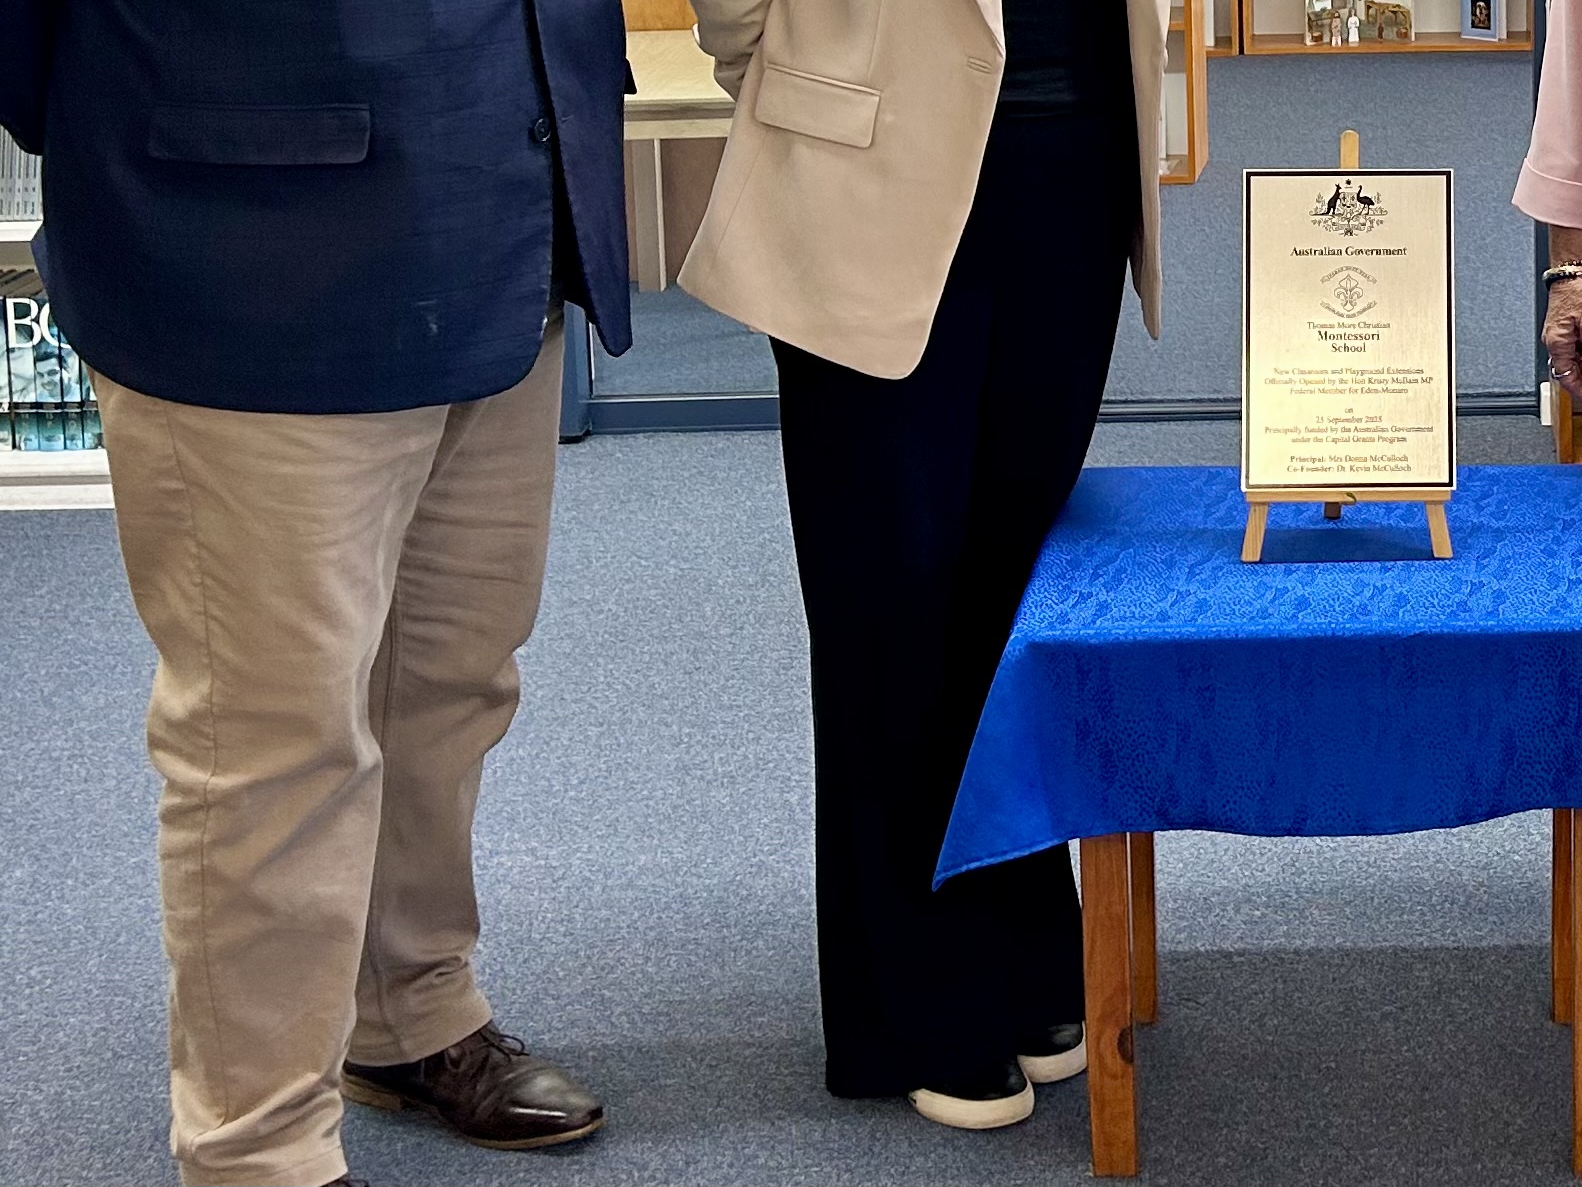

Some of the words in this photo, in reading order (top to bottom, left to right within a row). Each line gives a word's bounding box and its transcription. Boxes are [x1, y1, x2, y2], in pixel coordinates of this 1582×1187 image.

[1290, 246, 1342, 256] Australian
[1345, 246, 1407, 256] Government
[1307, 321, 1335, 329] Thomas
[1358, 320, 1391, 329] Christian
[1318, 330, 1380, 341] Montessori
[1331, 342, 1367, 352] School
[1345, 367, 1384, 376] Playground
[1328, 377, 1336, 386] by
[1421, 376, 1433, 384] MP
[1327, 416, 1363, 425] September
